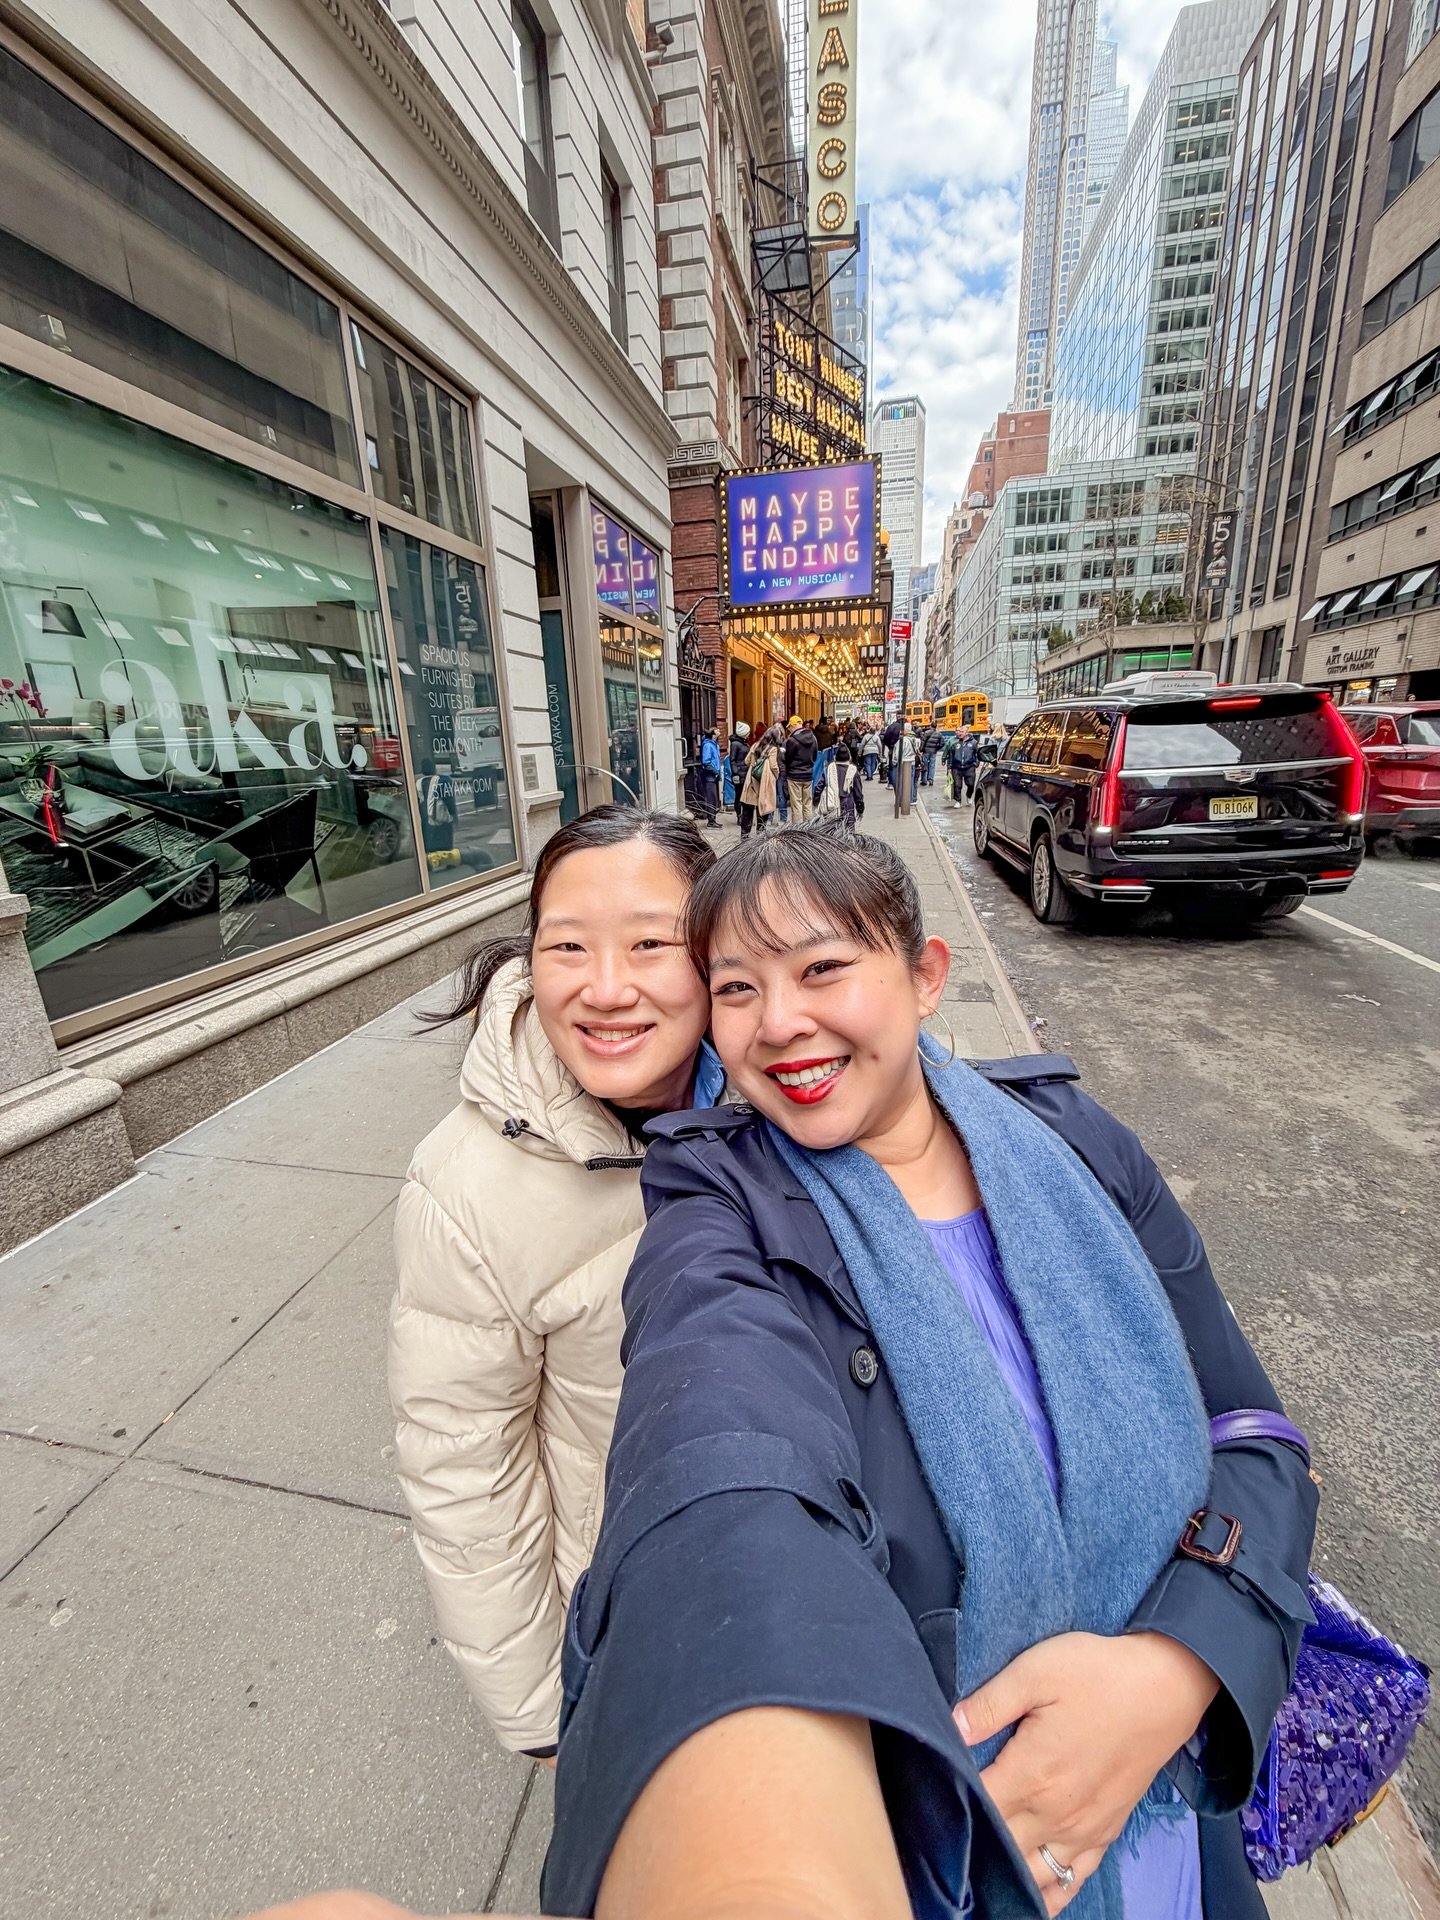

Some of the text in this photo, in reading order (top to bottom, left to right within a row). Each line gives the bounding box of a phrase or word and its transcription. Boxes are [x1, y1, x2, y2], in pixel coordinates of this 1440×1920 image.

[774, 320, 862, 403] TONY WINNER
[775, 369, 867, 447] BEST MUSICAL
[771, 413, 819, 461] MAYBE
[740, 487, 860, 521] MAYBE
[742, 514, 861, 546] HAPPY
[1211, 520, 1231, 542] 15
[743, 541, 860, 572] ENDING
[759, 573, 845, 589] A NEW MUSICAL
[422, 644, 470, 667] SPACIOUS
[1326, 646, 1380, 666] ART GALLERY
[421, 668, 476, 689] FURNISHED
[1327, 661, 1375, 674] CUSTOM FRAMING
[428, 692, 474, 710] SUITES BY
[431, 715, 477, 731] THE WEEK
[548, 684, 565, 766] STAYAKA.COM
[433, 738, 482, 754] OR MONTH
